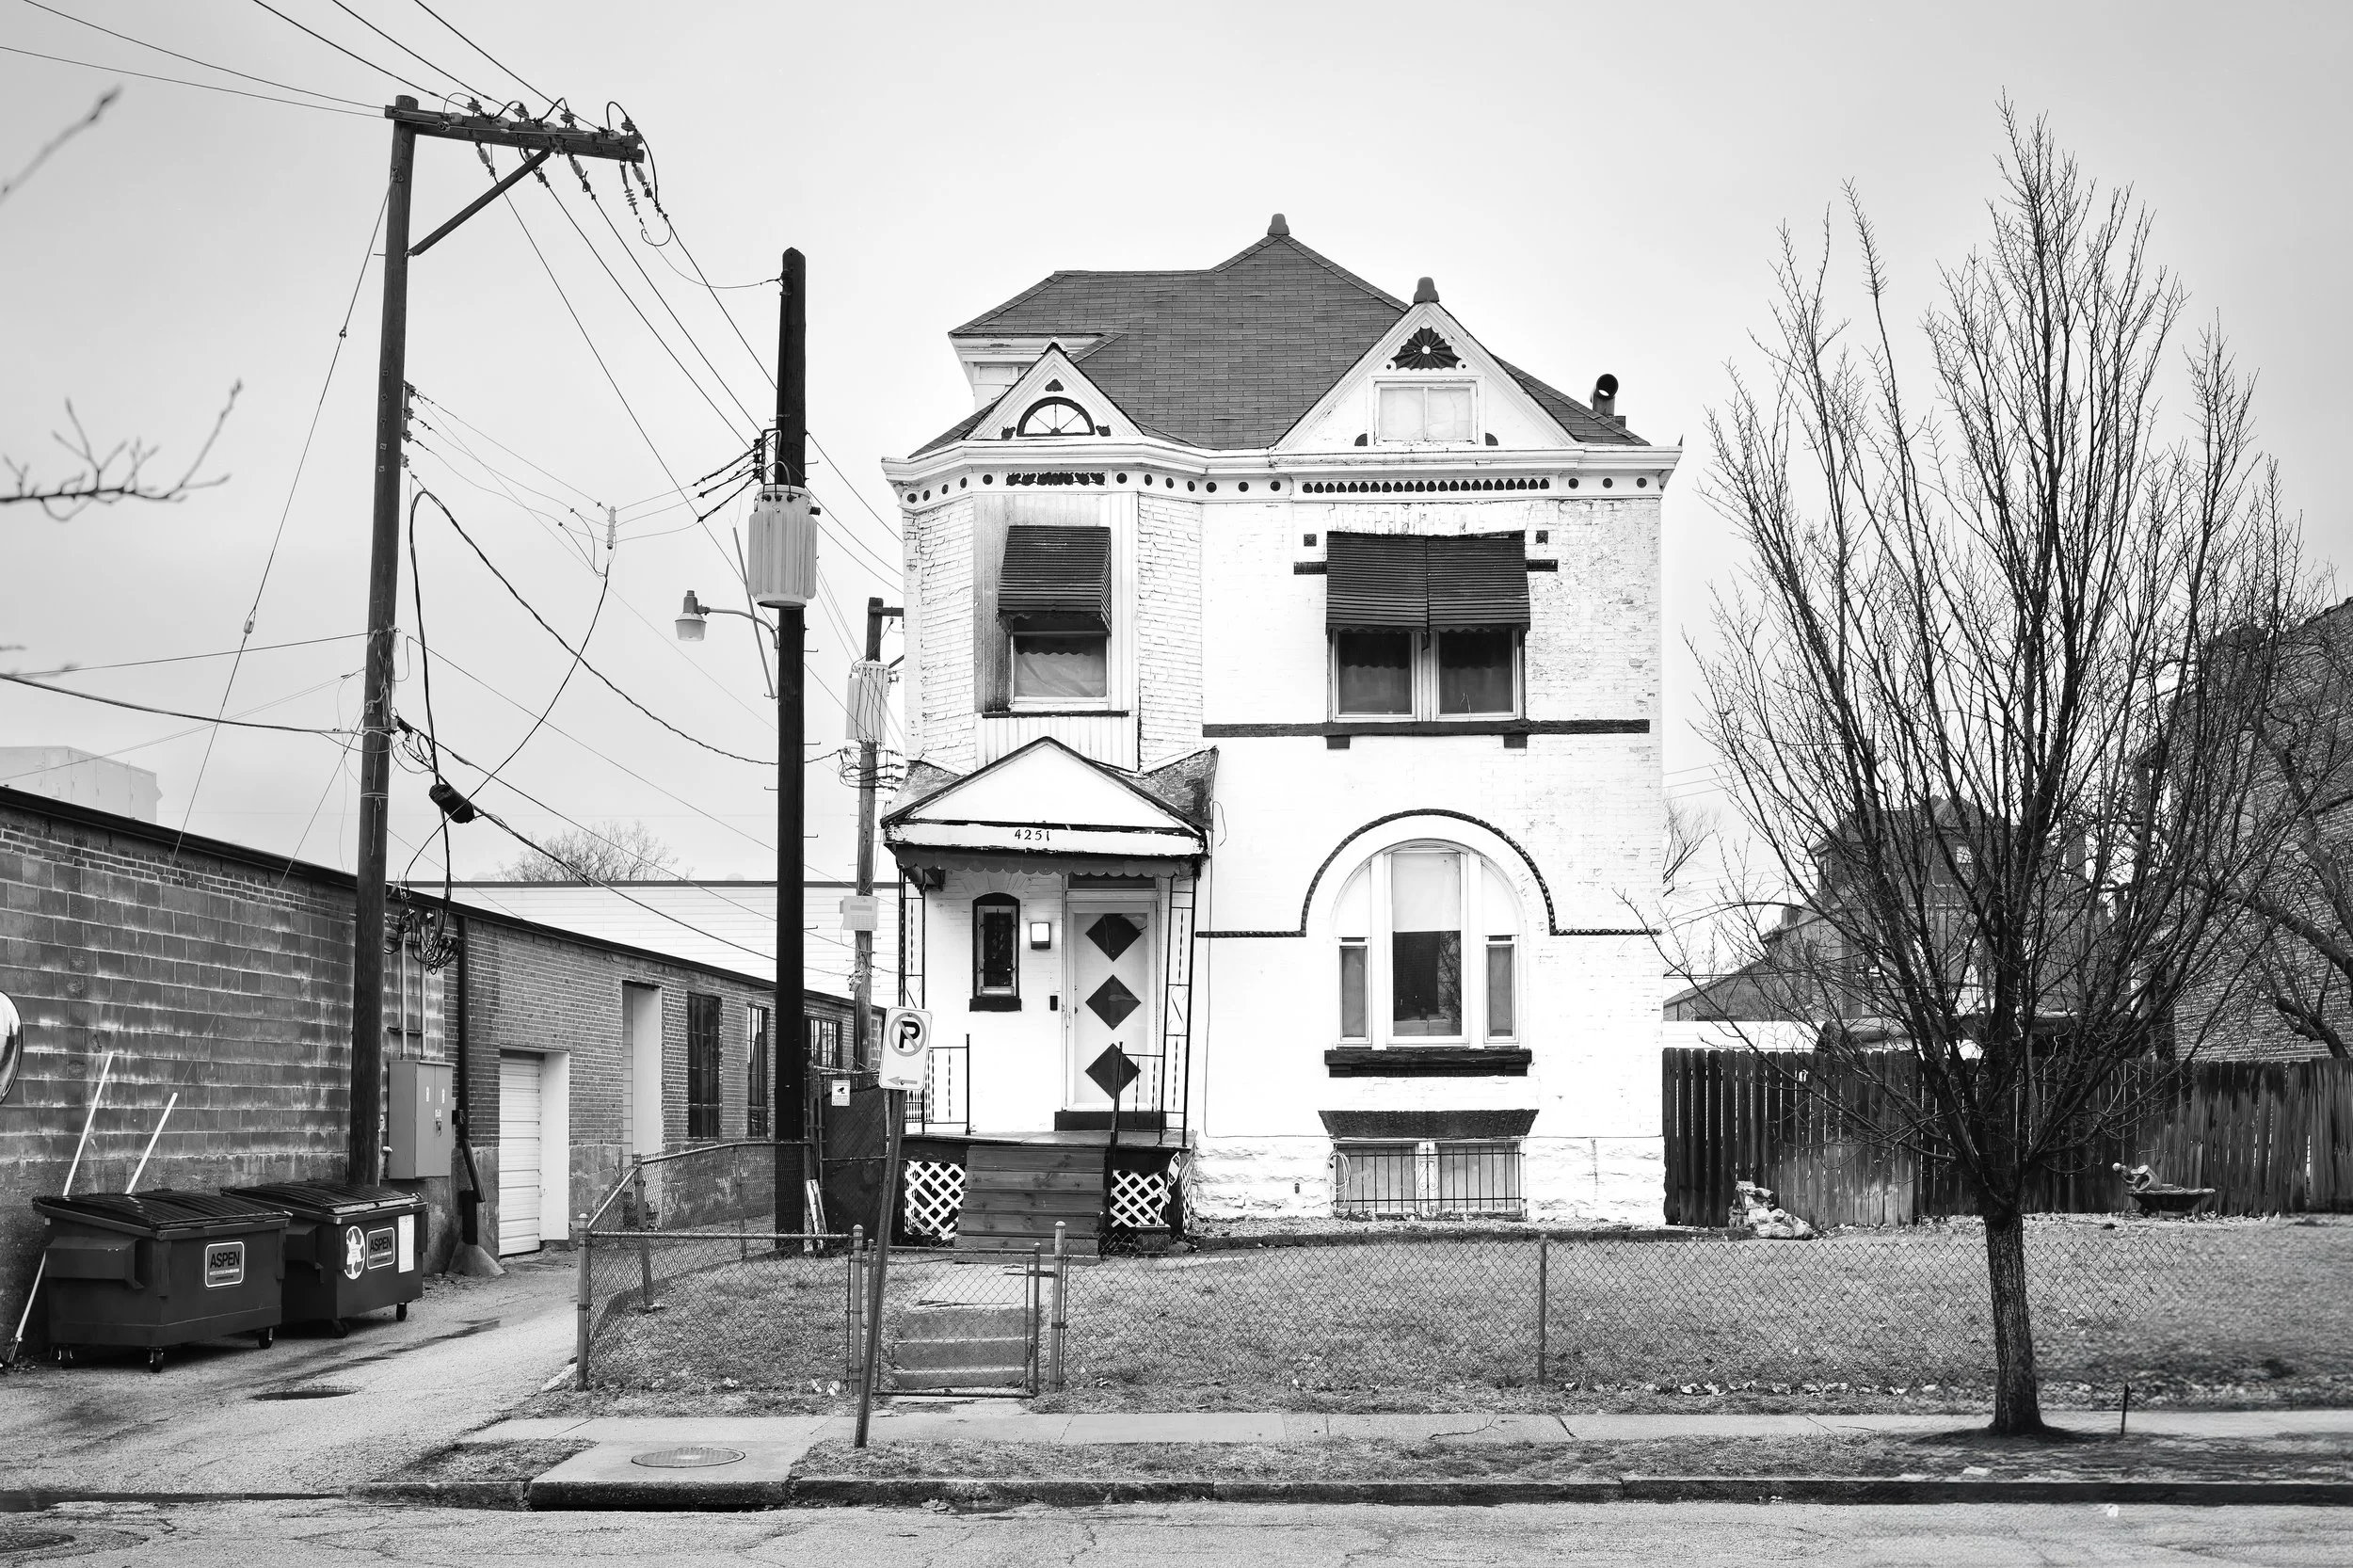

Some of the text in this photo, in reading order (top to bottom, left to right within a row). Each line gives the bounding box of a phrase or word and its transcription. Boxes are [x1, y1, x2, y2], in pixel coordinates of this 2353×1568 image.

[1015, 829, 1049, 841] 4251
[899, 1020, 920, 1048] P
[369, 1236, 392, 1253] ASPEN
[209, 1251, 240, 1269] ASPEN
